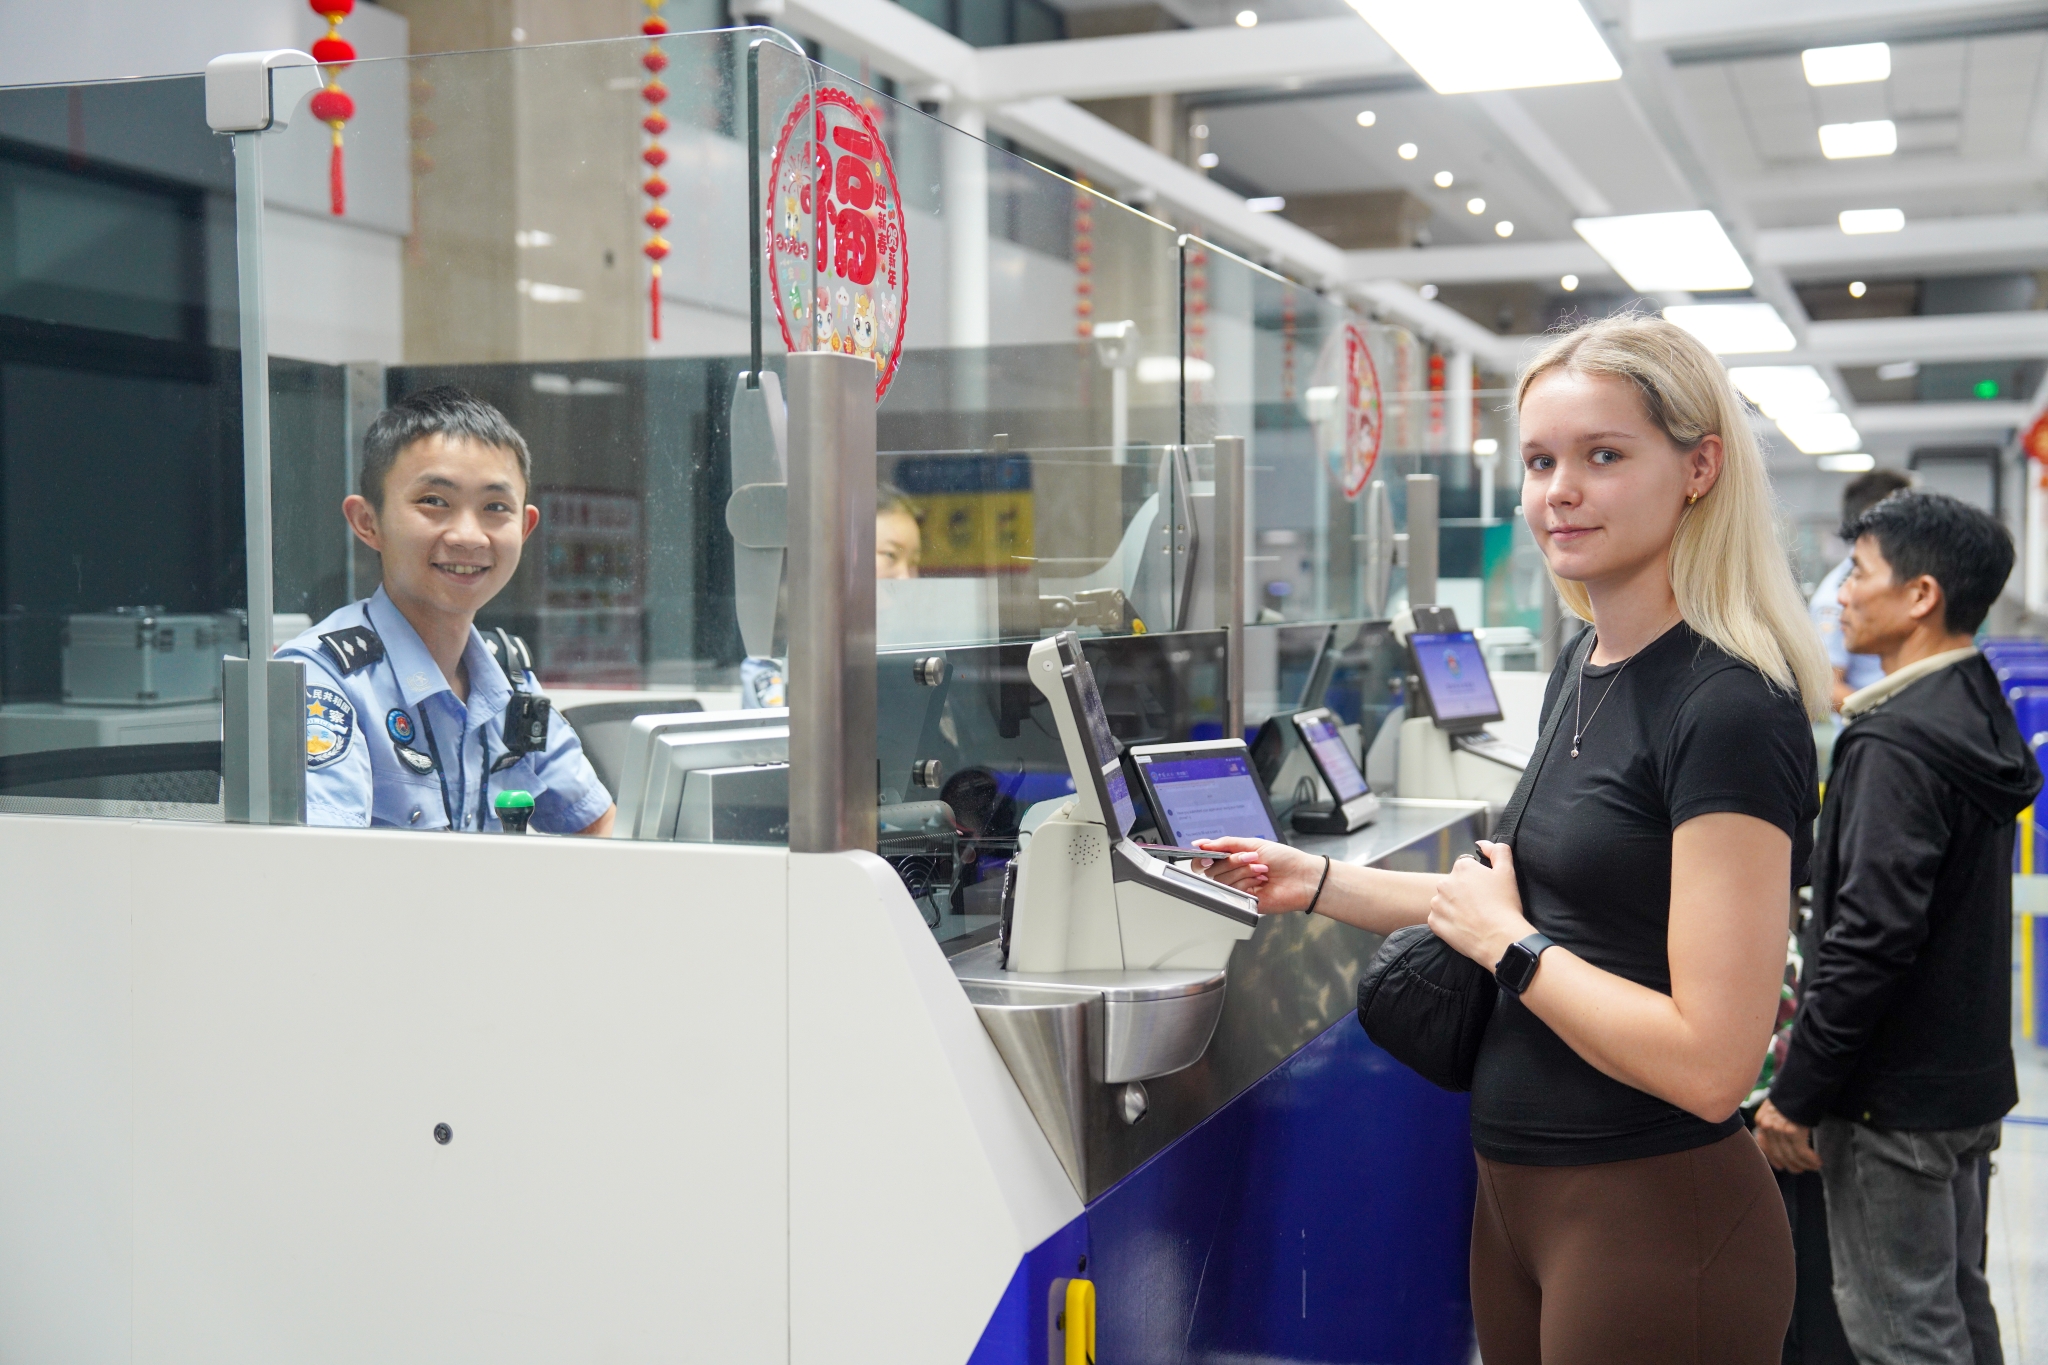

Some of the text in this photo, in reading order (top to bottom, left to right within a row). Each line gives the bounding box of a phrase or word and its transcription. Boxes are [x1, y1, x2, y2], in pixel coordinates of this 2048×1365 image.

[801, 110, 876, 285] 福
[875, 183, 887, 255] 迎新春
[887, 225, 898, 290] 贺新年
